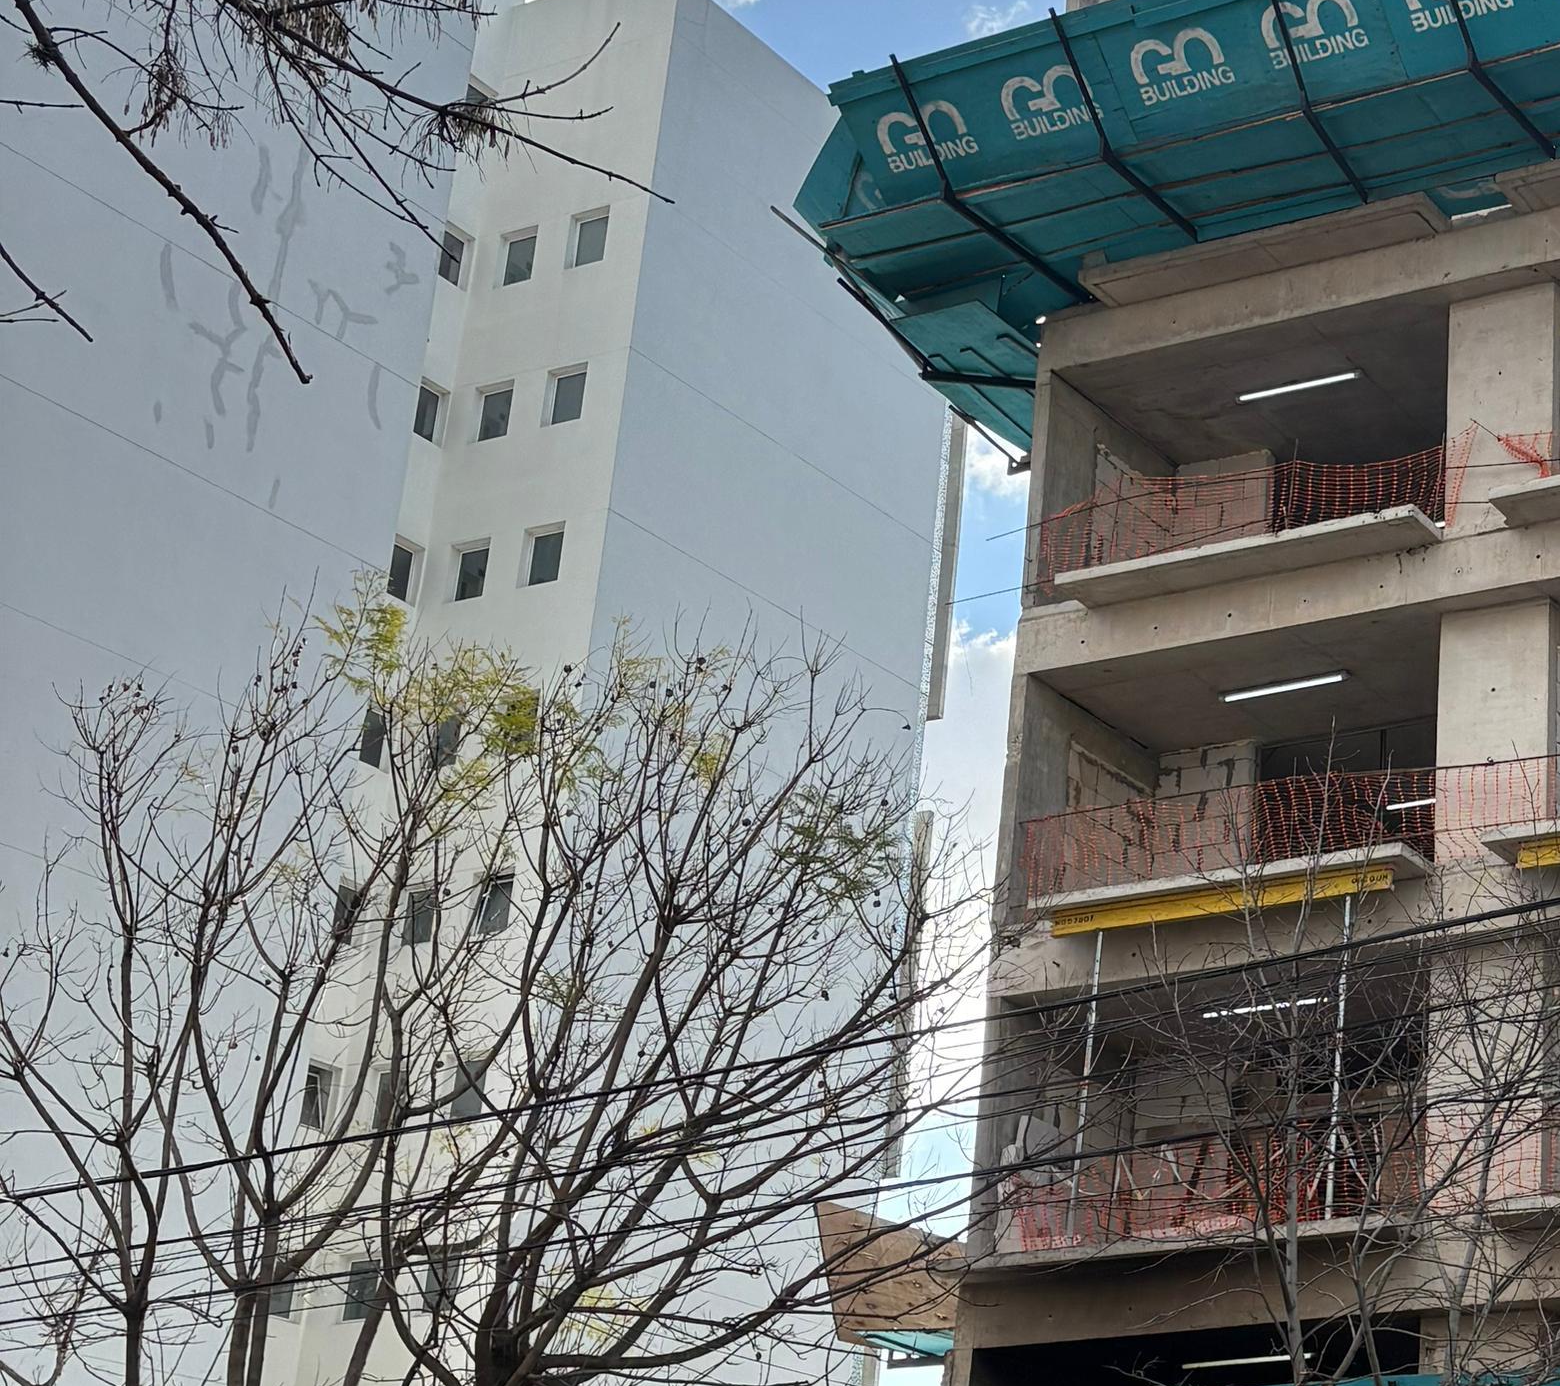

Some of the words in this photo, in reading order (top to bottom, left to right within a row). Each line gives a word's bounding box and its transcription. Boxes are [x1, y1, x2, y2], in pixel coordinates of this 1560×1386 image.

[1130, 27, 1226, 85] GO
[1269, 28, 1369, 71] BUILDING
[1000, 64, 1094, 121] GO
[1139, 65, 1236, 108] BUILDING
[876, 99, 968, 155] GO
